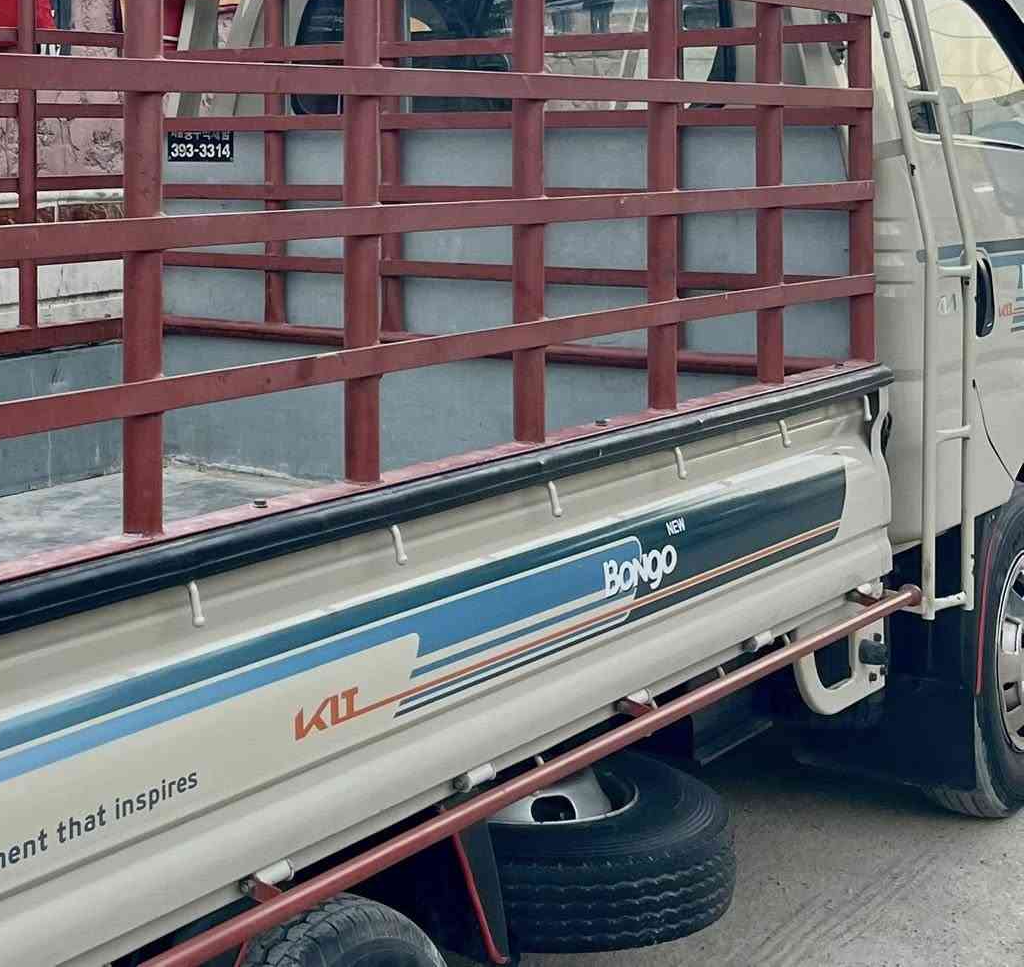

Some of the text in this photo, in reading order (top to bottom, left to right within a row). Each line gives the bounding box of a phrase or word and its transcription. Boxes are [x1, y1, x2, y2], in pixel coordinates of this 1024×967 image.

[171, 143, 230, 158] 393-3314
[666, 517, 686, 536] NEW
[57, 805, 106, 844] that
[115, 770, 199, 820] inspires
